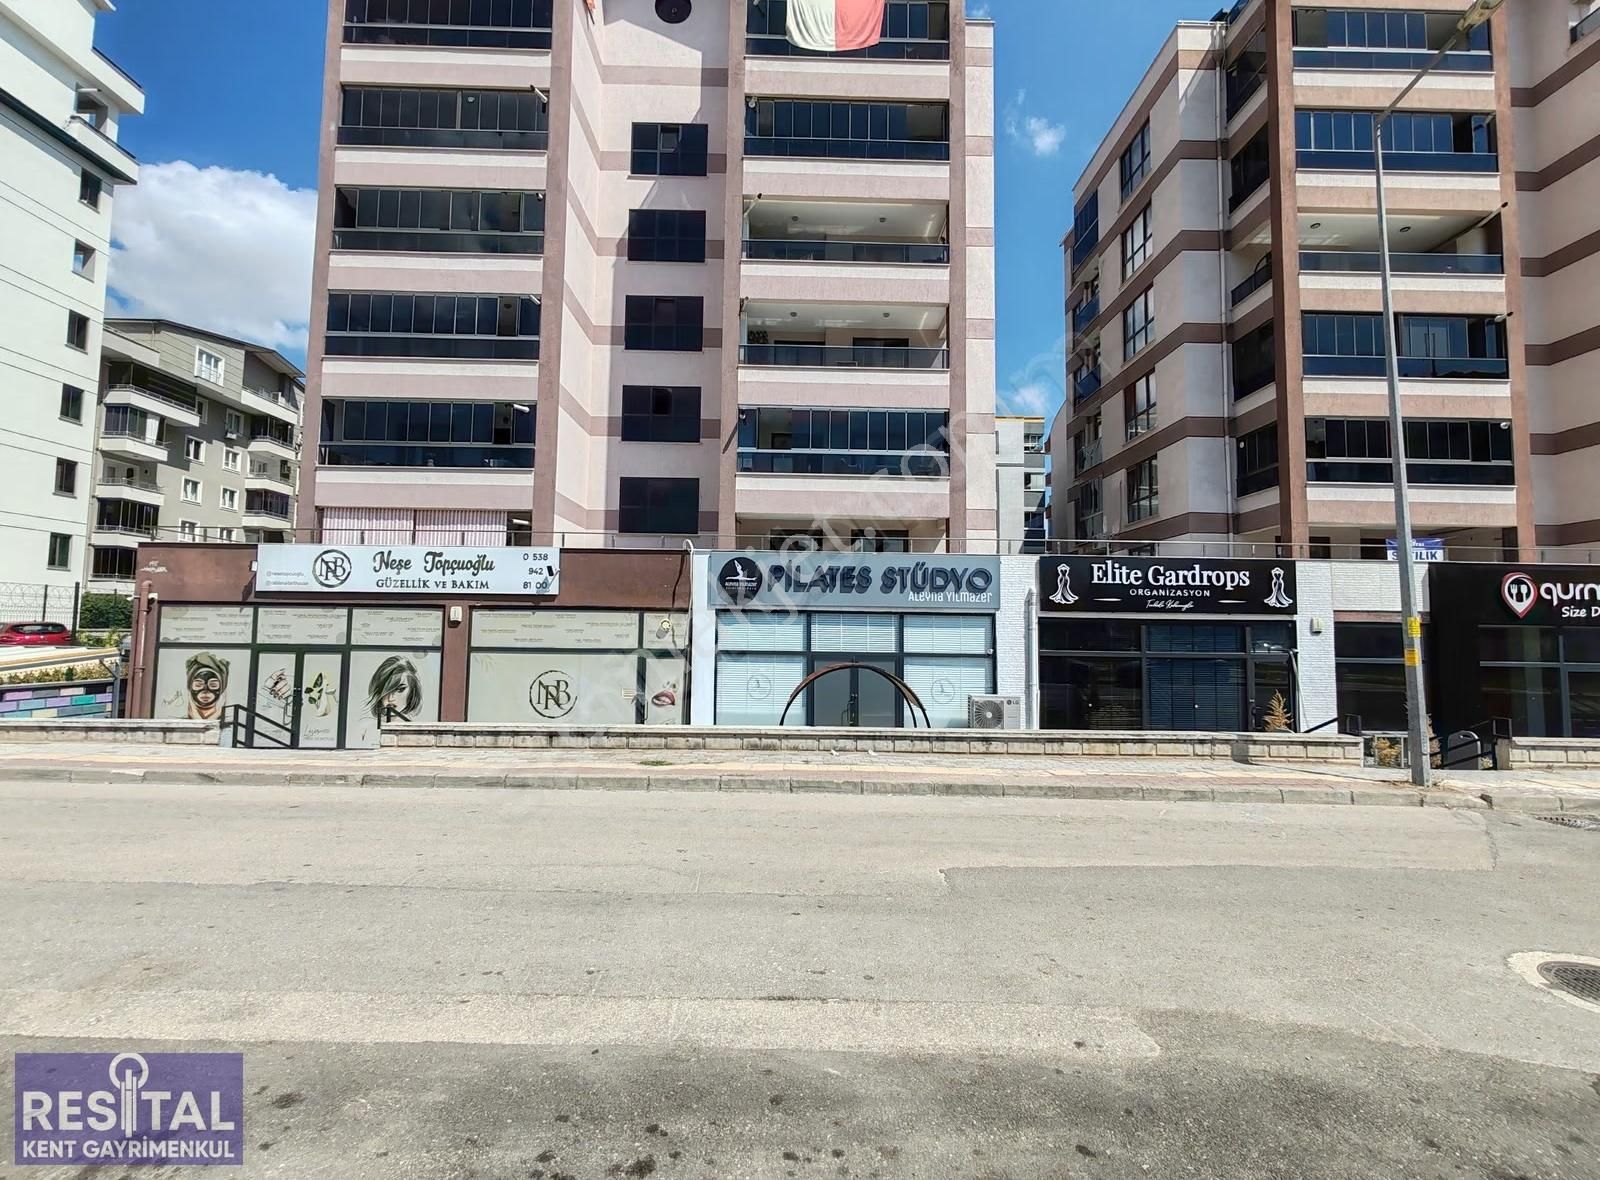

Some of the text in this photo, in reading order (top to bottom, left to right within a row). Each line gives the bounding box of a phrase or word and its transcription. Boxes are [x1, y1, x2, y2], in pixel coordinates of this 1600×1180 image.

[532, 553, 549, 561] 538
[1391, 551, 1438, 560] SILIK
[373, 550, 496, 576] Neşe Topçuoğlu
[528, 567, 543, 575] 942
[1091, 560, 1250, 590] Elite Gardrops
[767, 560, 993, 595] PİLATES STÜDYO
[376, 577, 429, 589] GÜZELLİK
[452, 580, 489, 589] BAKIM
[522, 581, 548, 589] 81 00
[1129, 588, 1210, 597] ORGANİZASYON
[1561, 605, 1587, 618] Size
